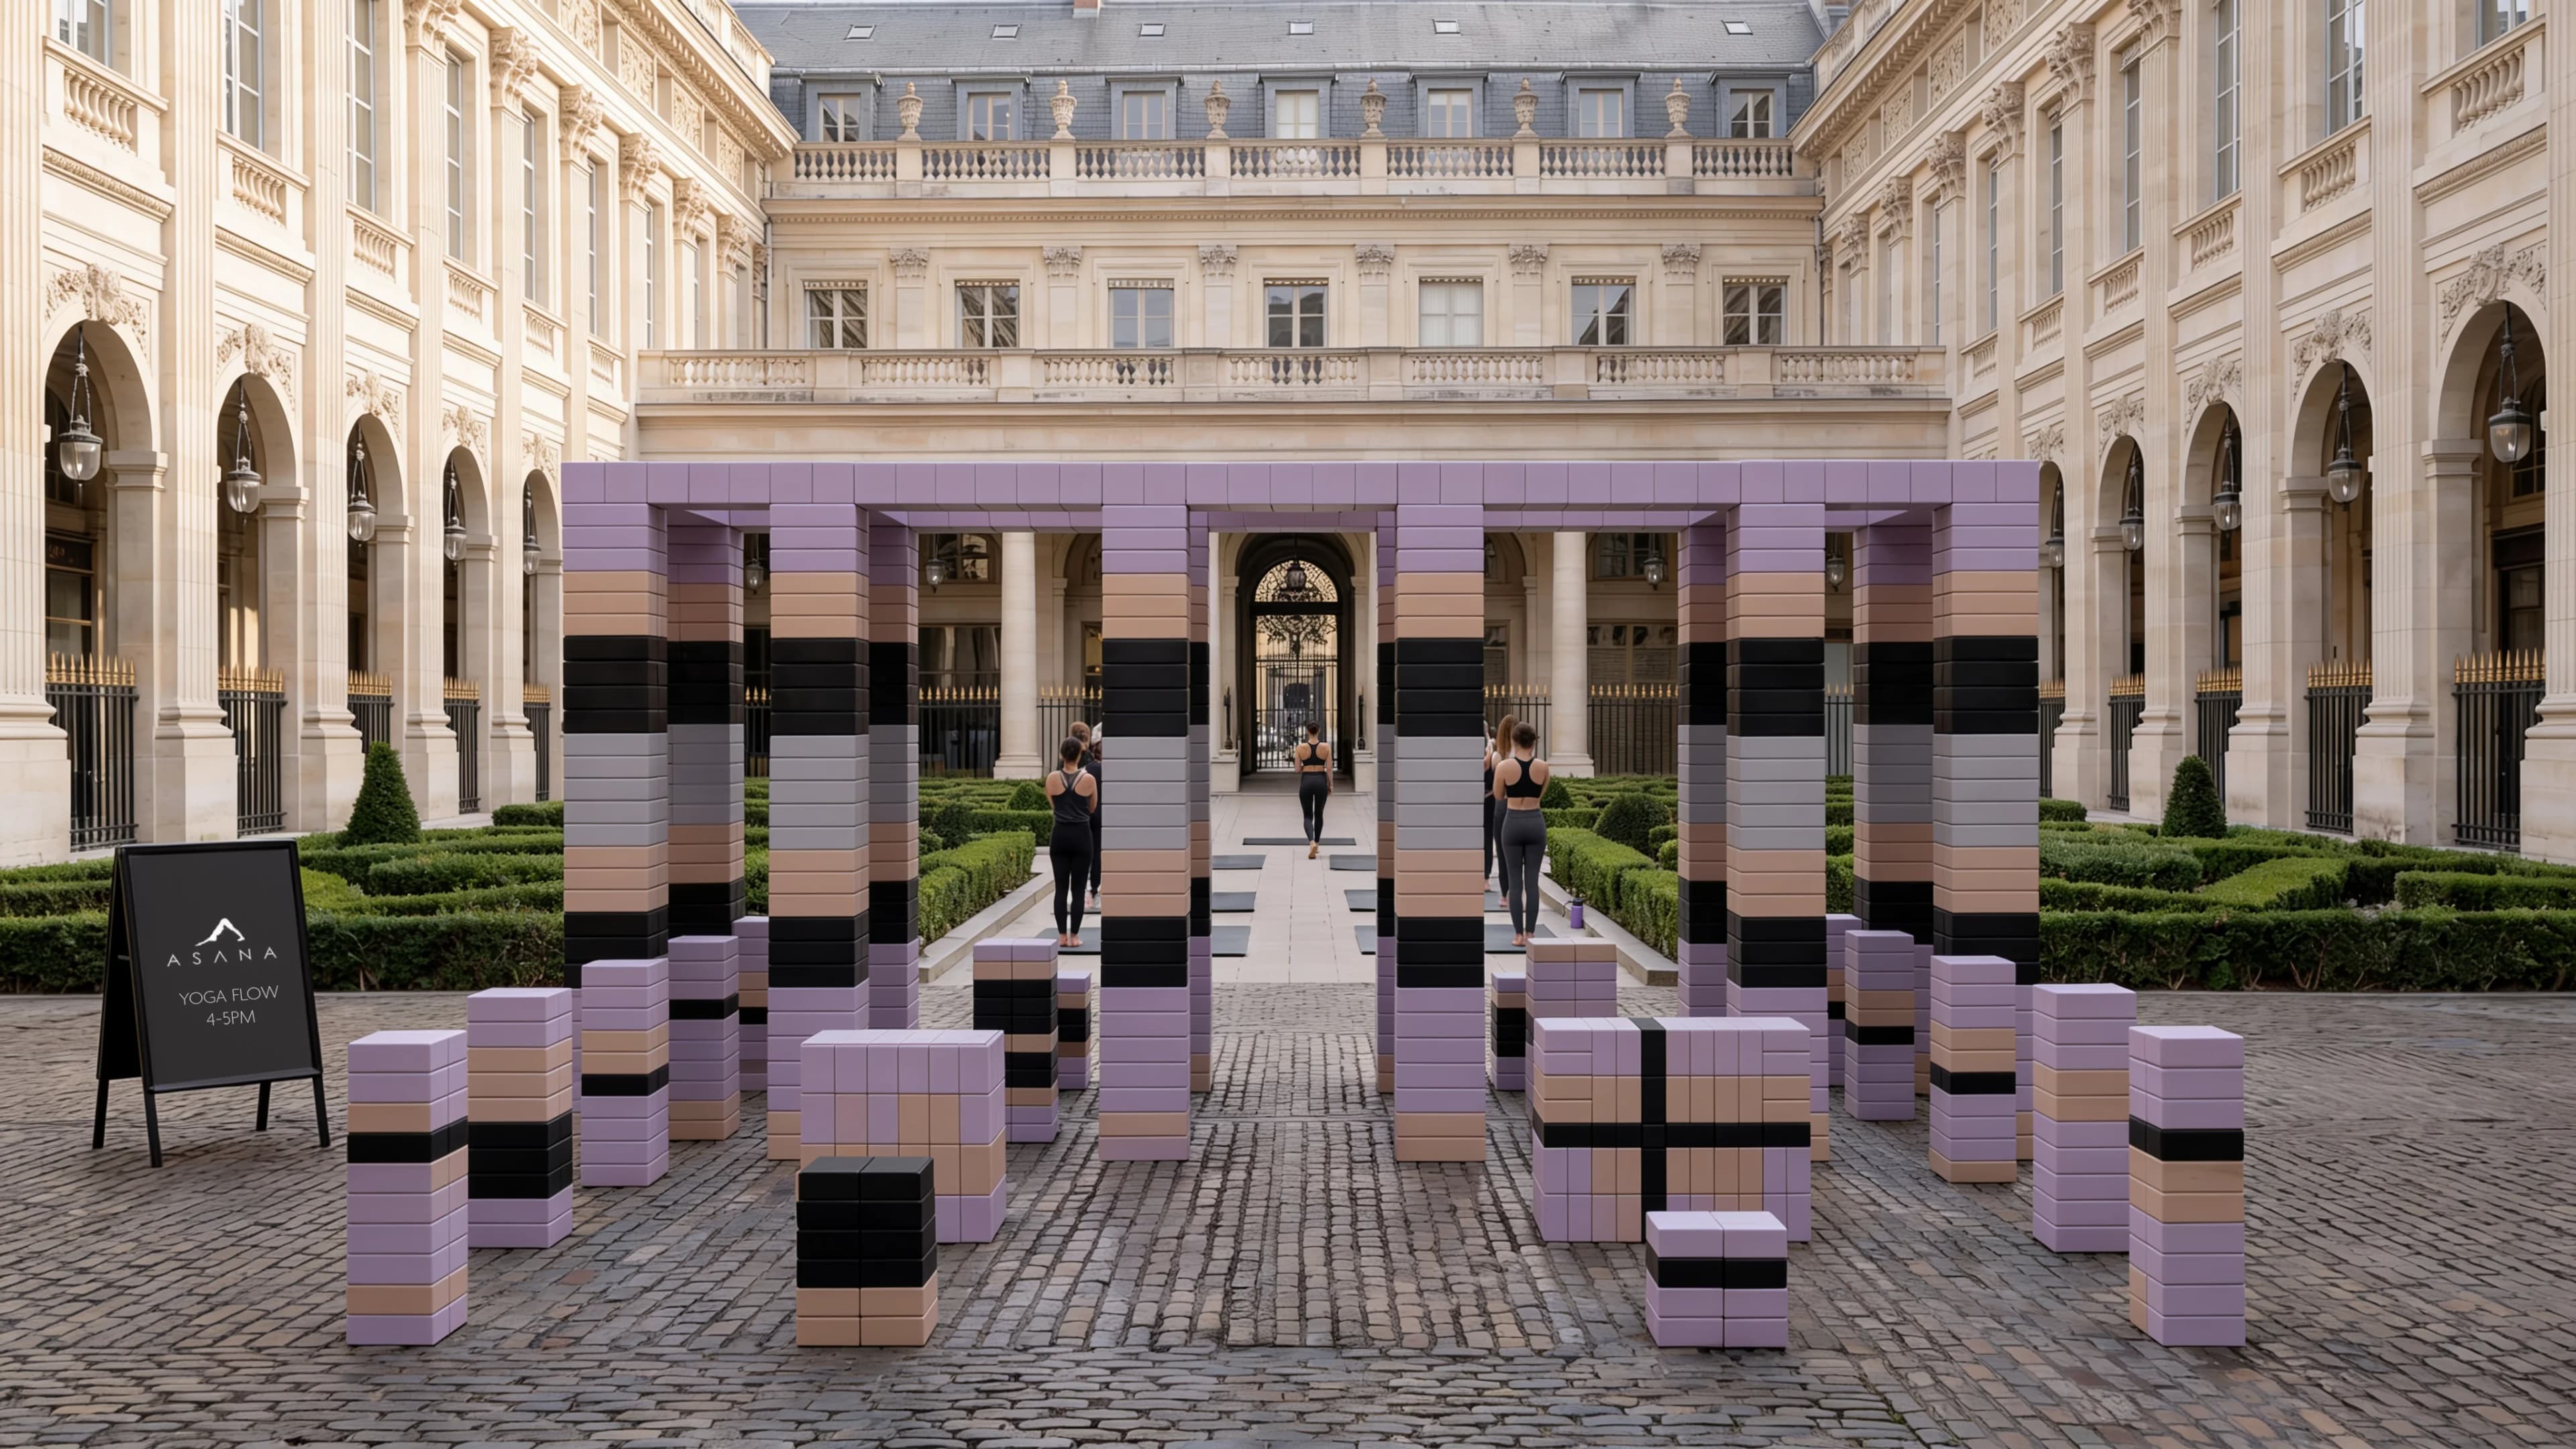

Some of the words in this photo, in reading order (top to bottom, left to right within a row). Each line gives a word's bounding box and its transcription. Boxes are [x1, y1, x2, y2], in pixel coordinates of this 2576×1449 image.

[166, 947, 277, 967] ASANA
[178, 989, 227, 1006] YOGA
[231, 985, 279, 1002] FLOW
[206, 1010, 256, 1026] 4-5PM
